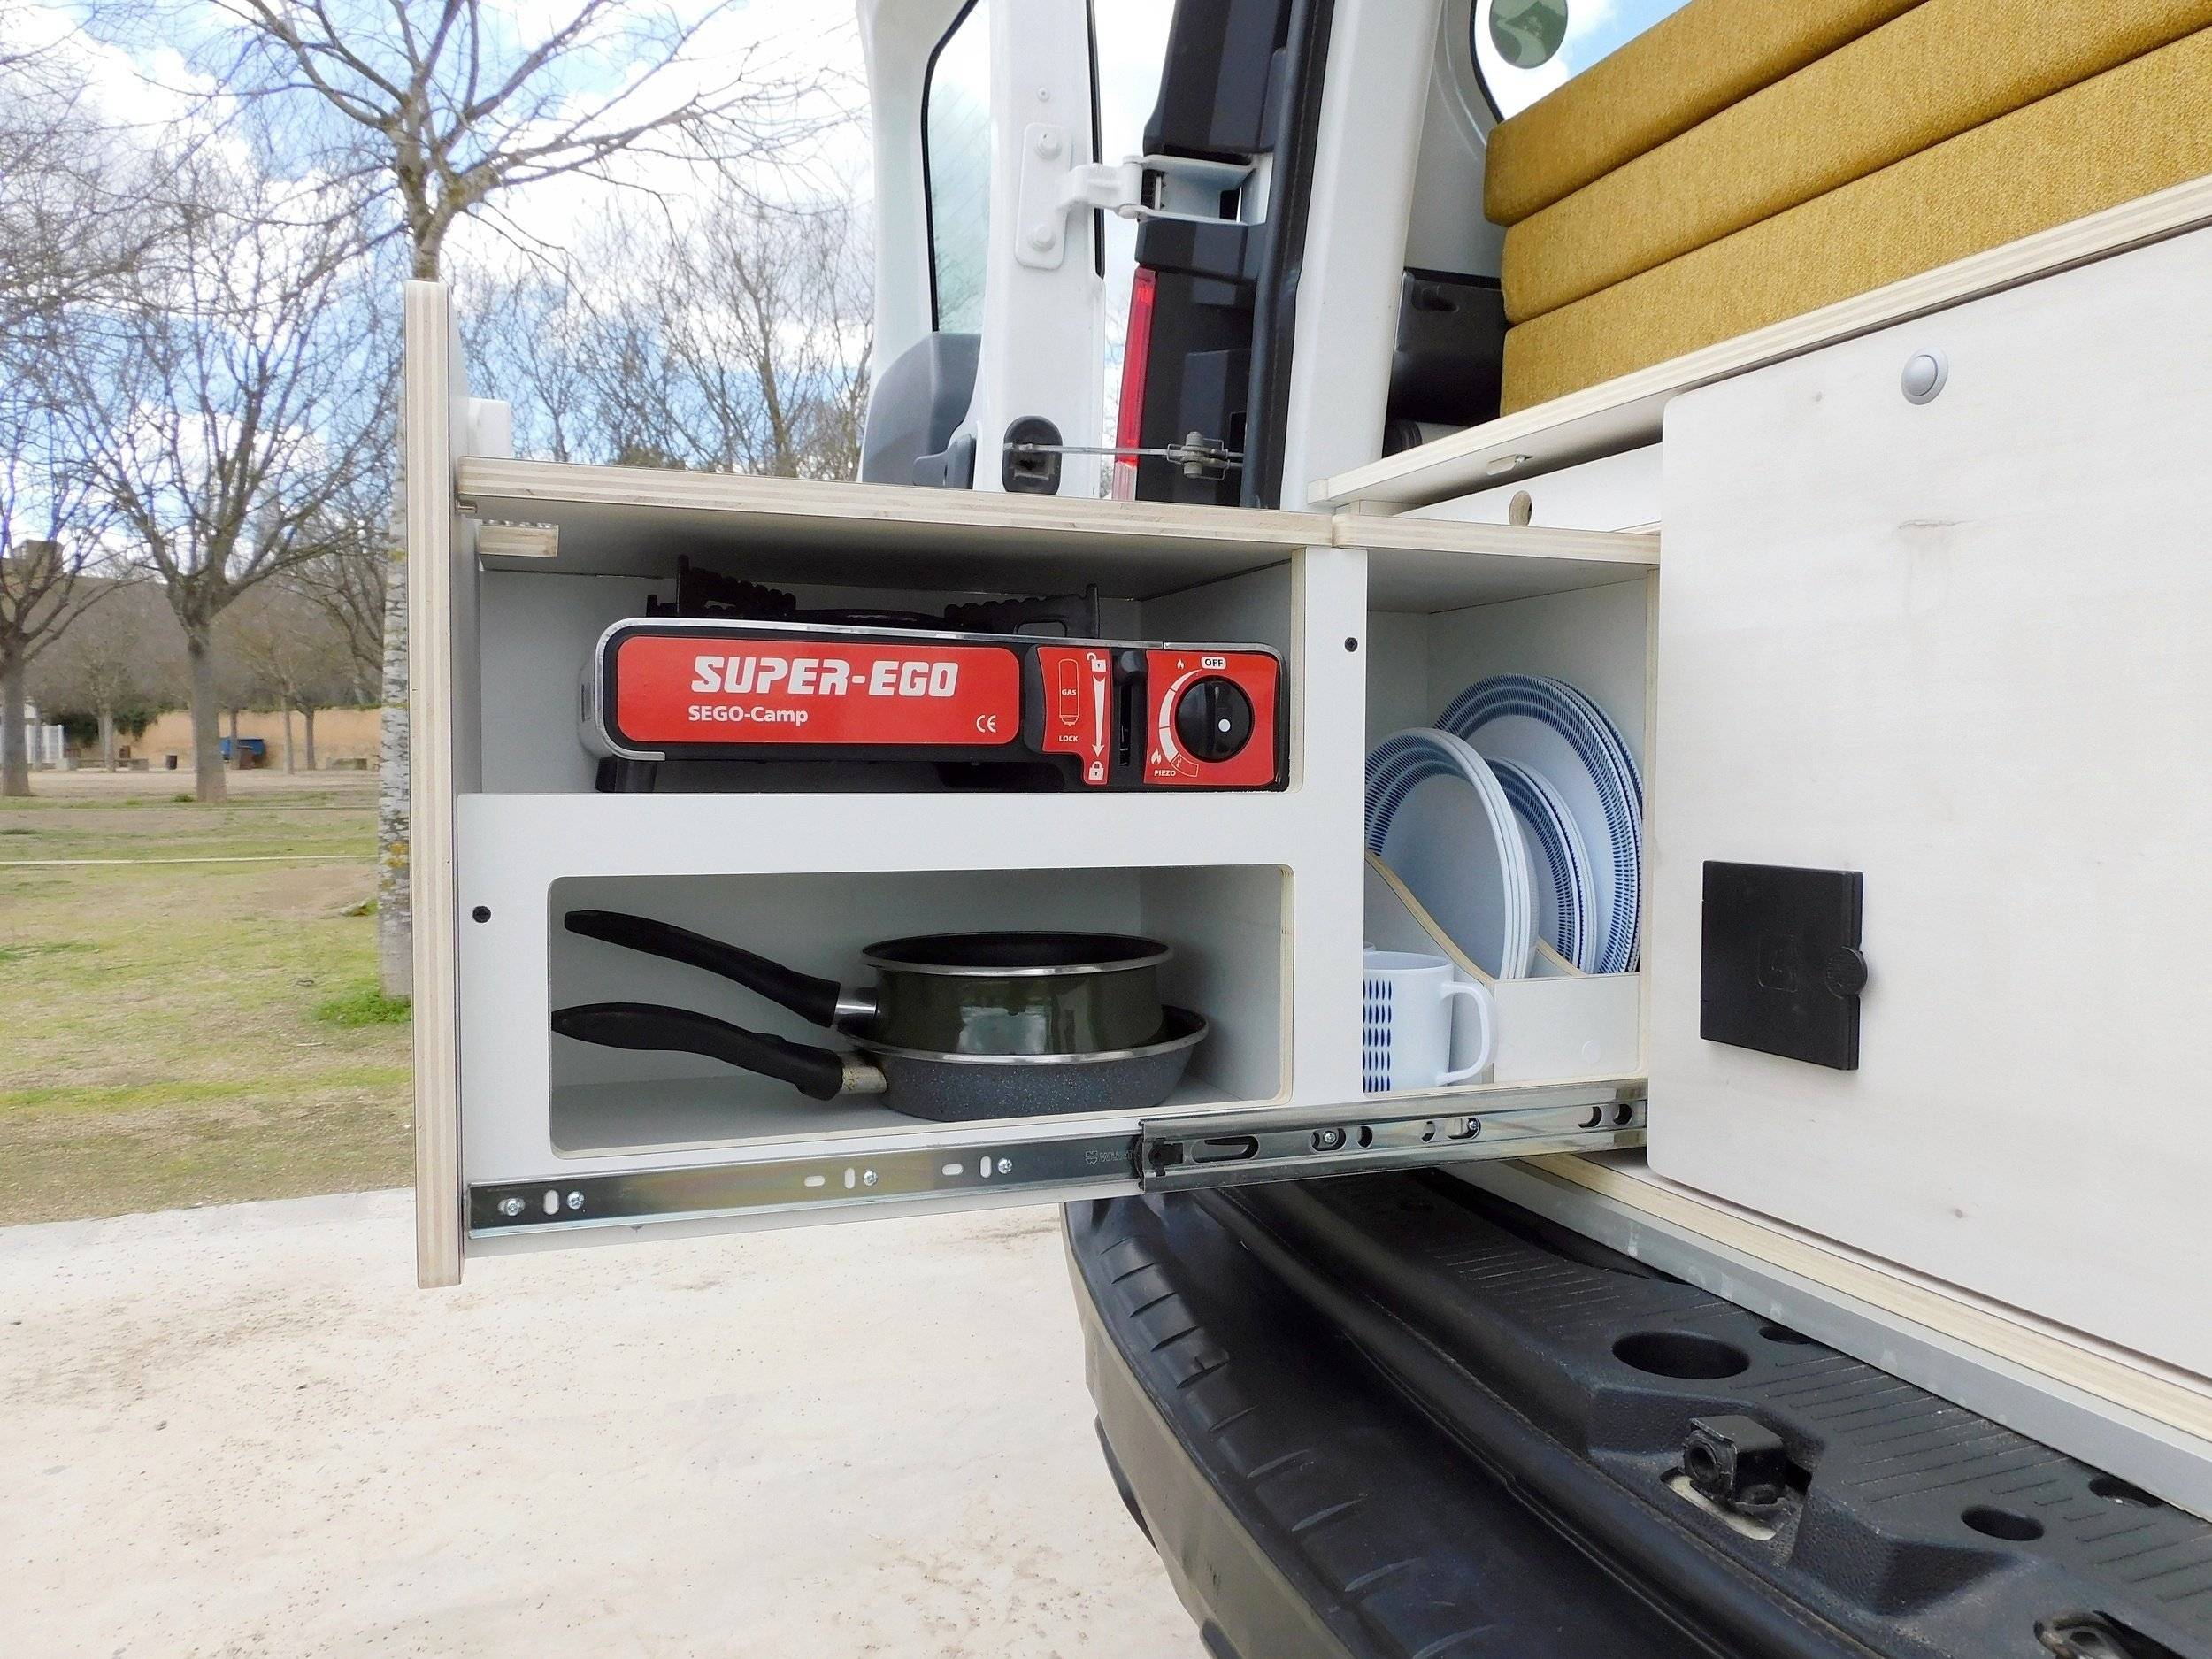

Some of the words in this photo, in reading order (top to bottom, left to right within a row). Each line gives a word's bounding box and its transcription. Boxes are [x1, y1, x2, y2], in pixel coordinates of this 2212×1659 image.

[1204, 657, 1224, 667] OFF
[690, 655, 959, 697] SUPER-EGO
[688, 705, 809, 726] SEGO-Camp
[976, 714, 996, 733] CE
